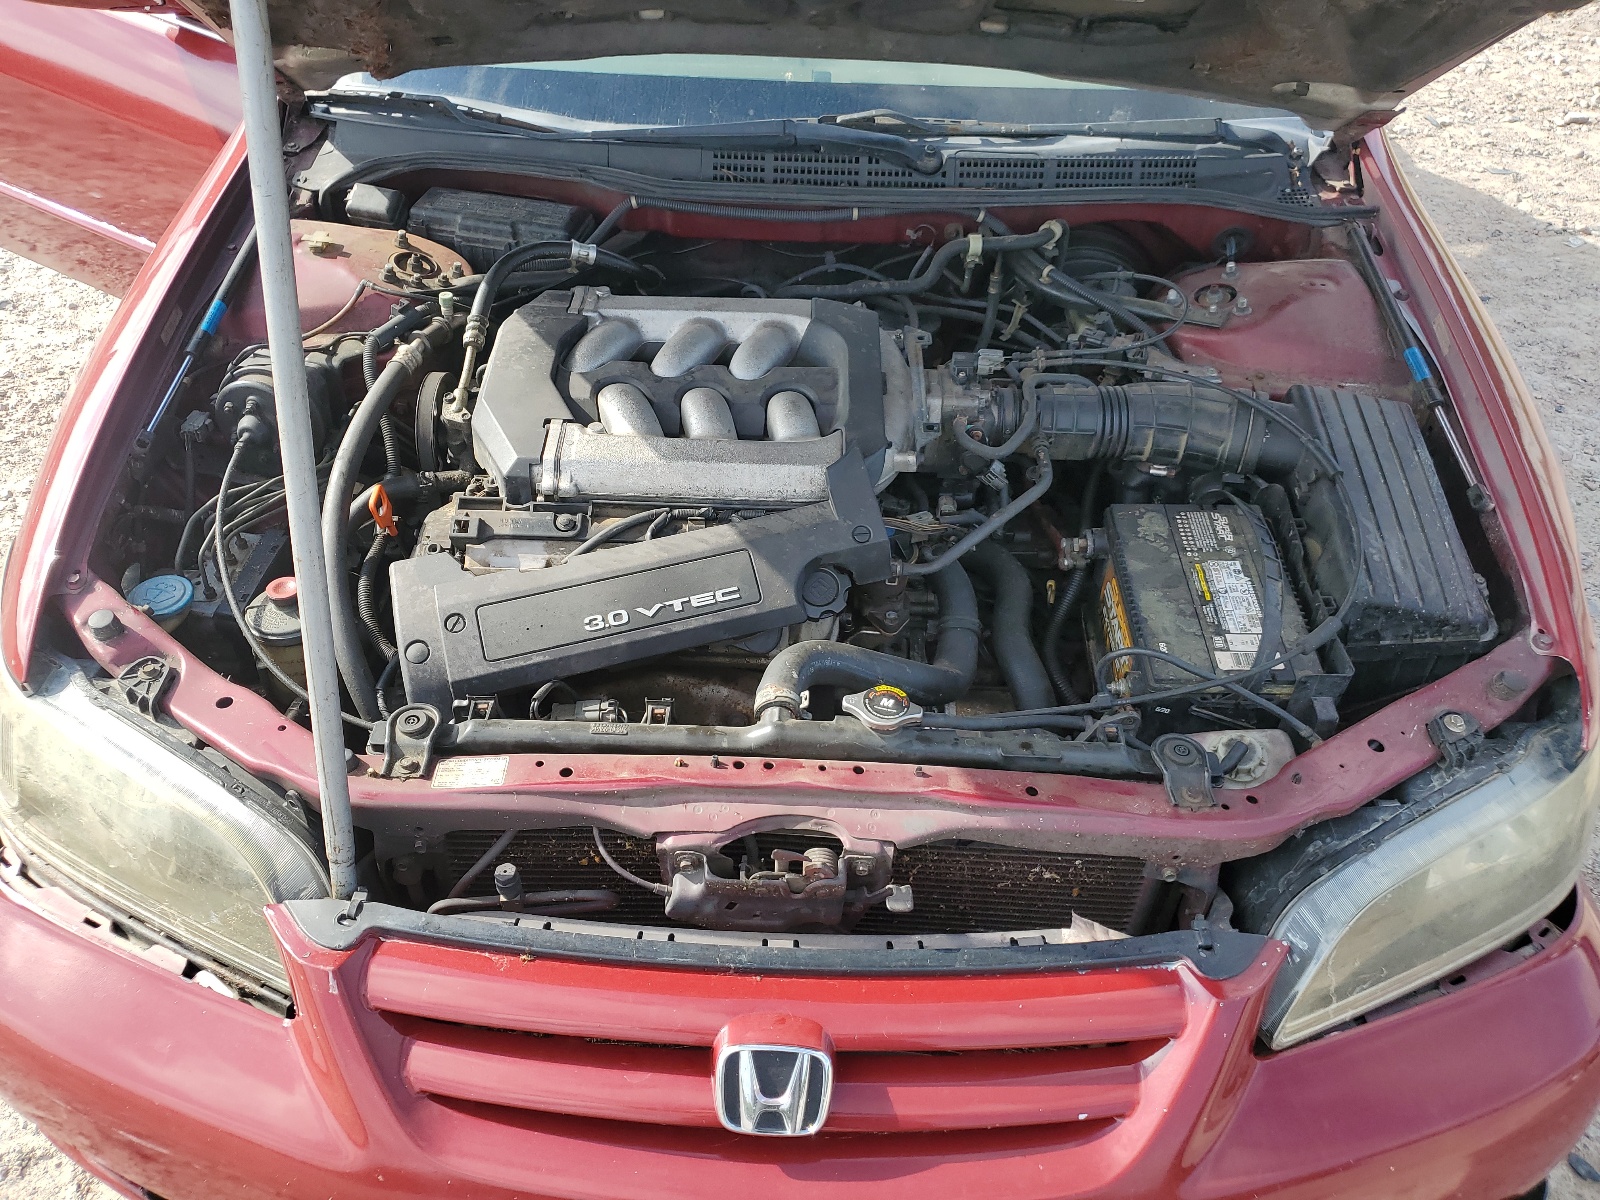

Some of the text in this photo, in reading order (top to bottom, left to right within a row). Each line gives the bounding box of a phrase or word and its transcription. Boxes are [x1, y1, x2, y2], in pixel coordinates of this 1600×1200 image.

[1211, 512, 1228, 542] START
[1220, 516, 1234, 541] SUPER
[583, 586, 742, 632] 3.0 VTEC
